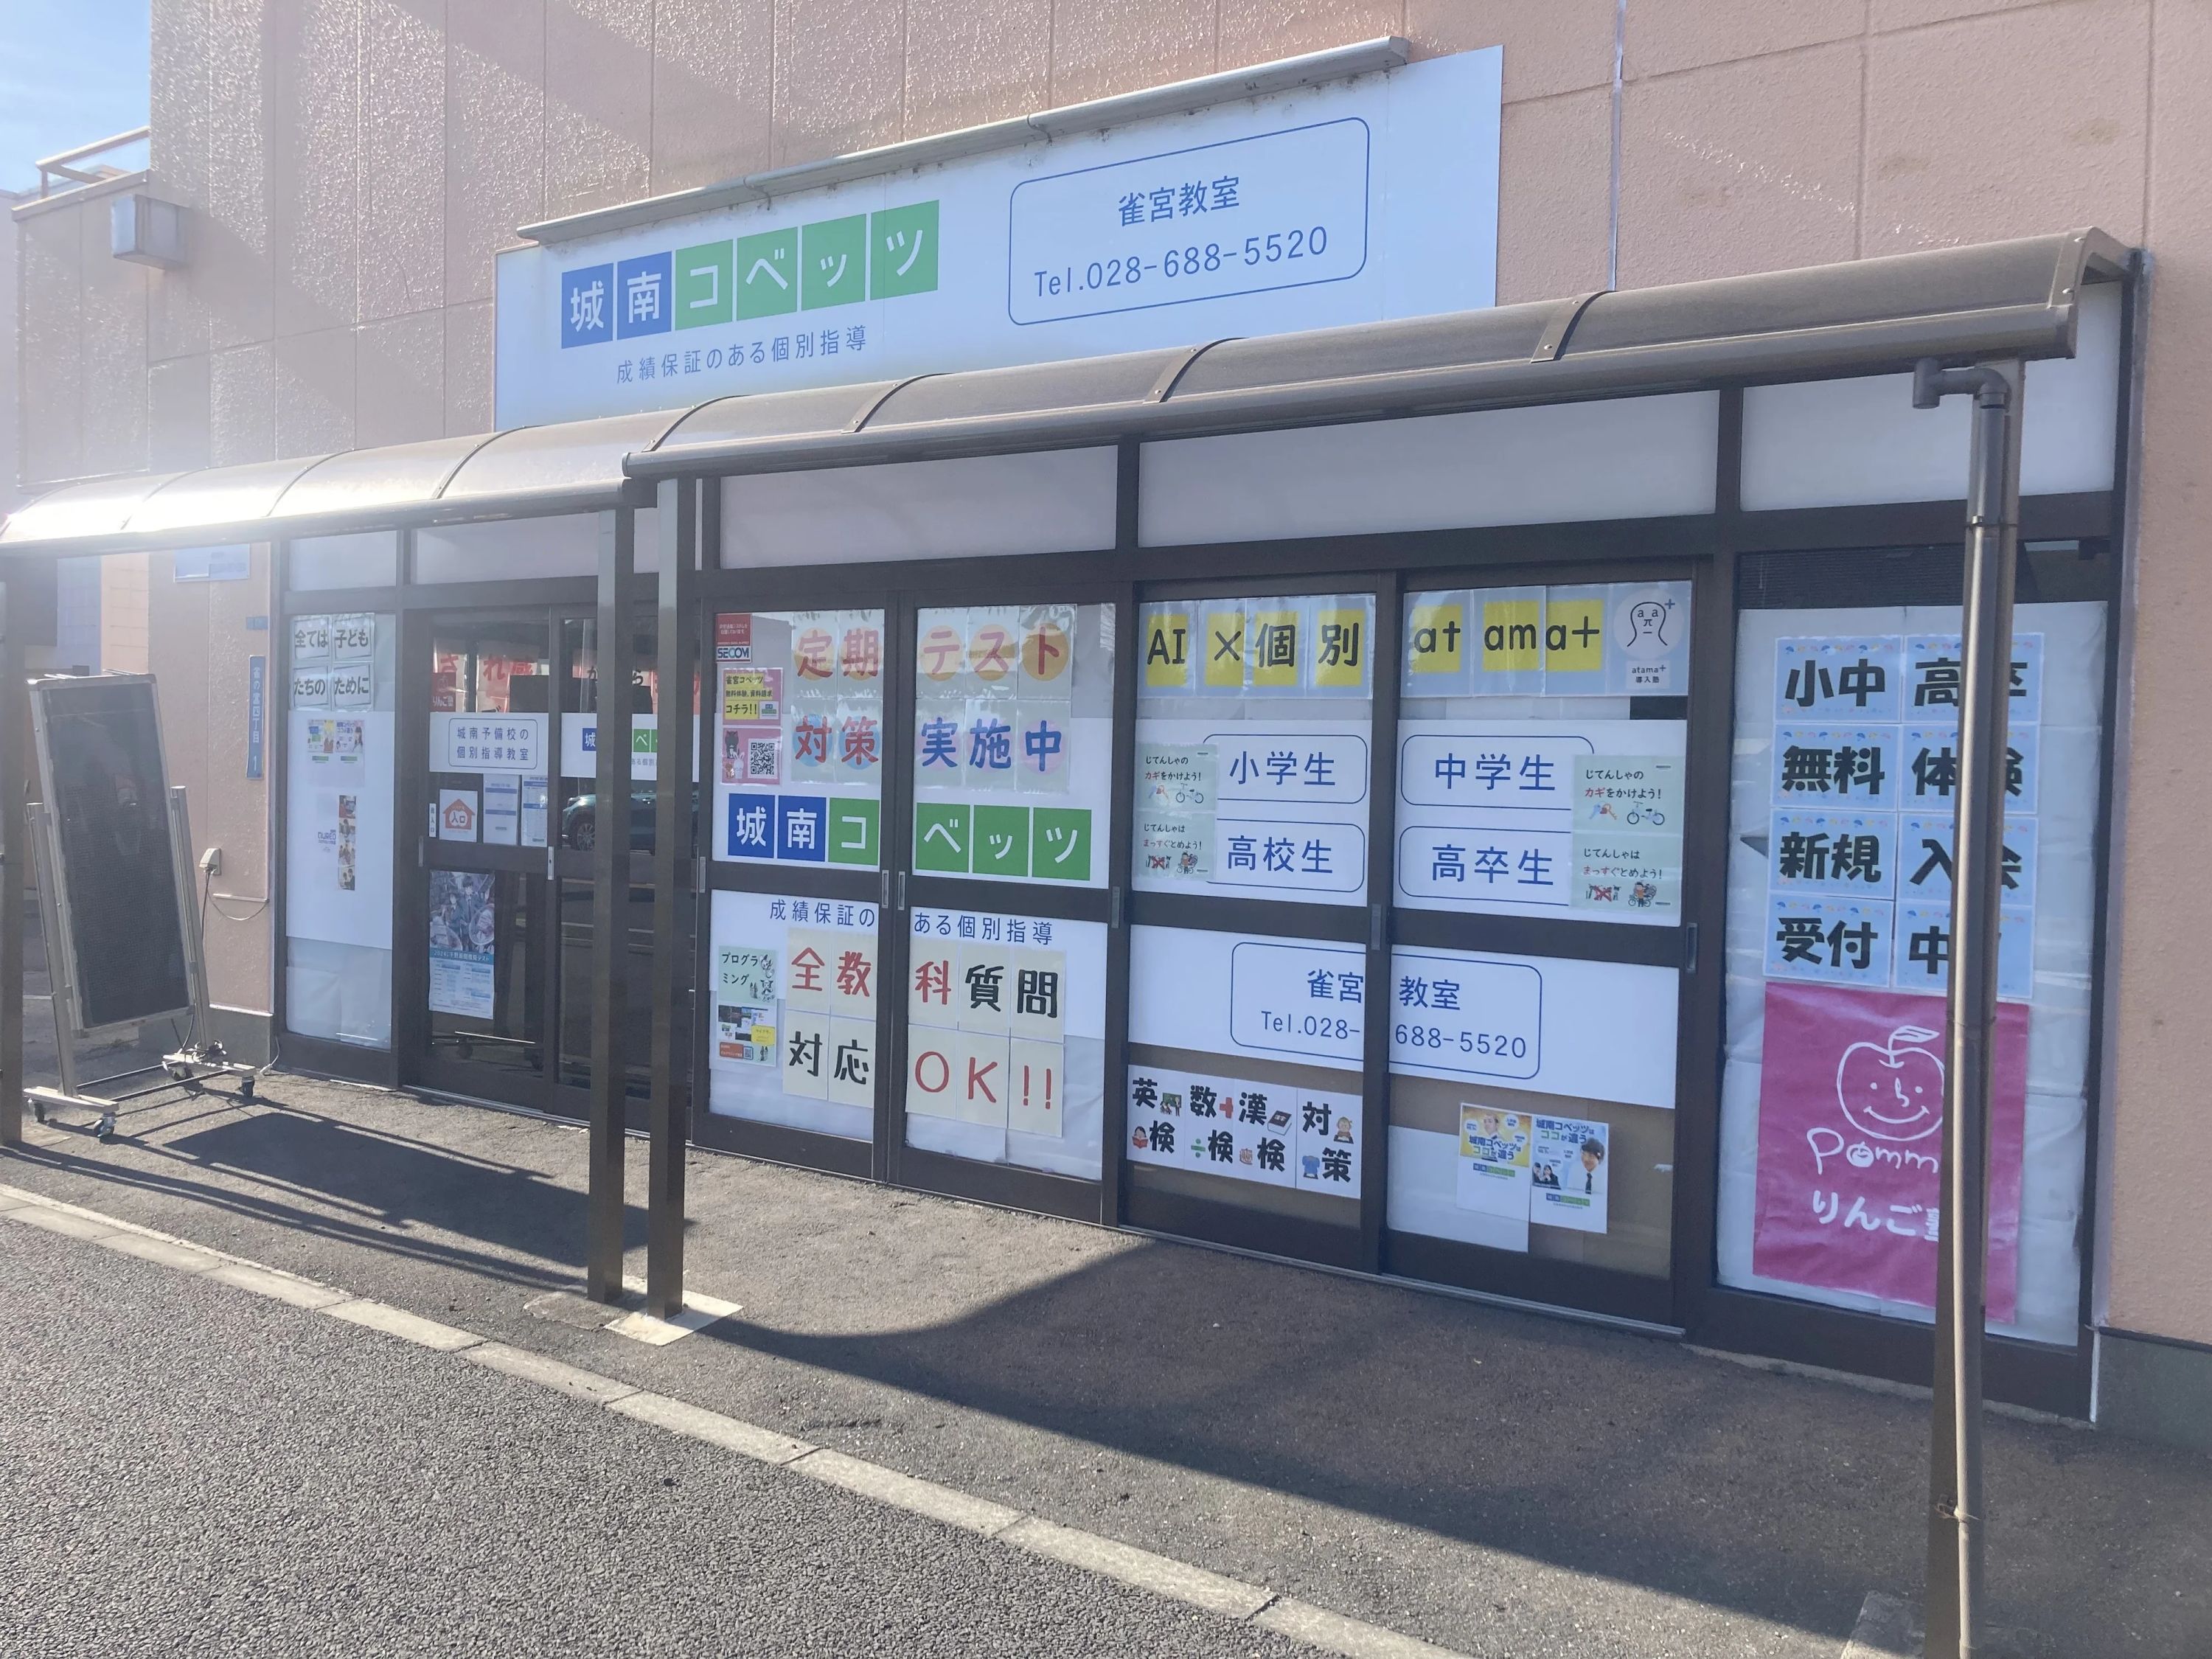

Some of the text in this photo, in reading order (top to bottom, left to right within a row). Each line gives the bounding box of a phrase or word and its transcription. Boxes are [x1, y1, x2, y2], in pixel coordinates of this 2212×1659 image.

[1118, 175, 1241, 227] 雀宮教室
[570, 229, 924, 333] 城南コベッツ
[1034, 225, 1328, 298] Tel.028-688-5520
[616, 324, 867, 384] 成績保証のある個別指導
[294, 628, 369, 649] 全ては 子ども
[717, 647, 750, 658] SECOM
[796, 625, 1060, 679] 定期 テスト
[293, 675, 369, 696] たちの ために
[1631, 664, 1666, 674] atama+
[1784, 658, 1885, 707] 小中
[456, 726, 529, 741] 城南予備校の
[456, 746, 529, 761] 個別指導教室
[794, 714, 1062, 772] 対策 実施中
[1145, 755, 1189, 765] じてんしゃの
[1228, 751, 1336, 787] 小学生
[1434, 752, 1556, 792] 中学生
[1585, 769, 1644, 780] じてんしゃの
[1781, 745, 1885, 796] 無料
[451, 811, 466, 824] 入口
[736, 807, 1078, 863] 城南コ ベッツ
[1144, 824, 1186, 833] じてんしゃは
[1226, 835, 1334, 874] 高校生
[1431, 843, 1554, 887] 高卒生
[1583, 847, 1641, 860] じてんしゃは
[1779, 830, 1882, 883] 新規
[770, 898, 1054, 946] 成績保証の ある個別指導
[1775, 917, 1879, 970] 受付
[722, 951, 759, 967] プログラ
[722, 973, 750, 986] ミング
[790, 947, 1059, 1018] 全教 科質問
[1307, 969, 1461, 1011] 雀宮 教室
[1261, 1010, 1527, 1059] Tel.028- 688-5520
[788, 1030, 869, 1085] 対応
[1806, 1127, 1939, 1175] Pomm
